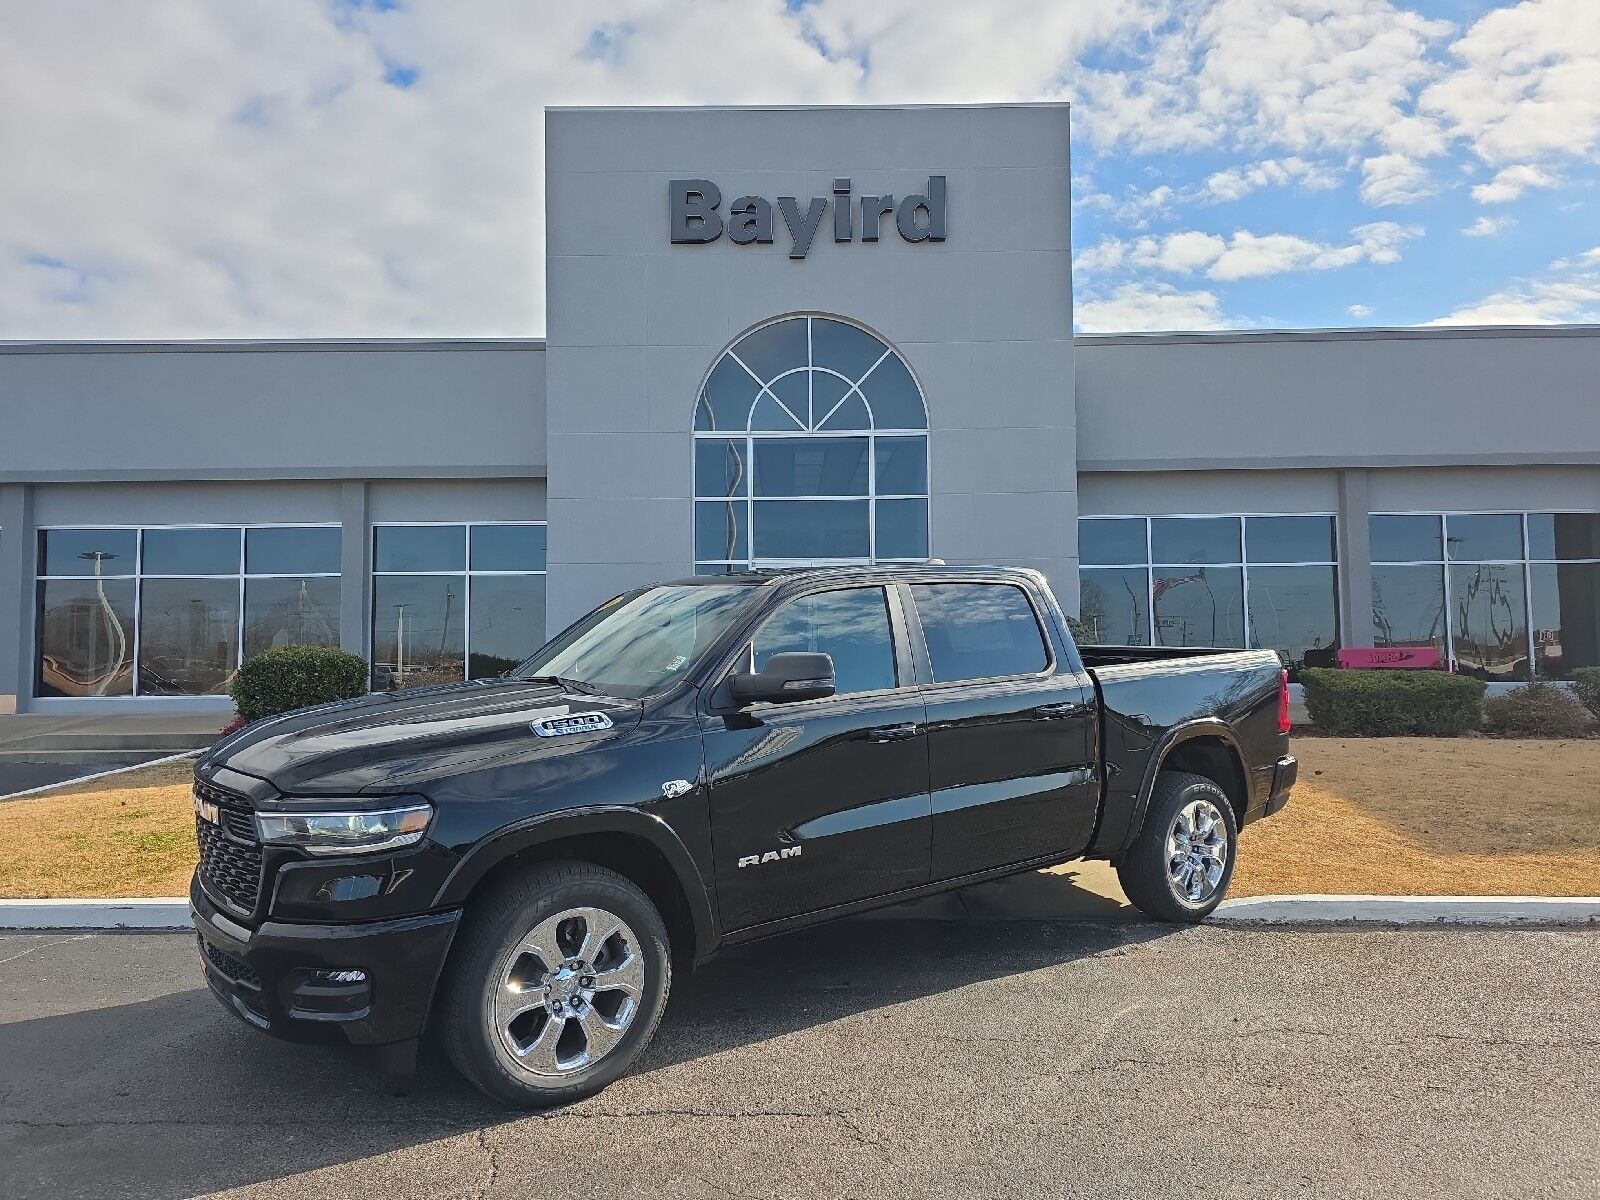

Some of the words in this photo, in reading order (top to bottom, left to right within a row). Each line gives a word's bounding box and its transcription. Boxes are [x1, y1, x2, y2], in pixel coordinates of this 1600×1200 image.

[669, 176, 947, 259] Bayird
[546, 715, 600, 730] 1500
[738, 845, 801, 868] RAM
